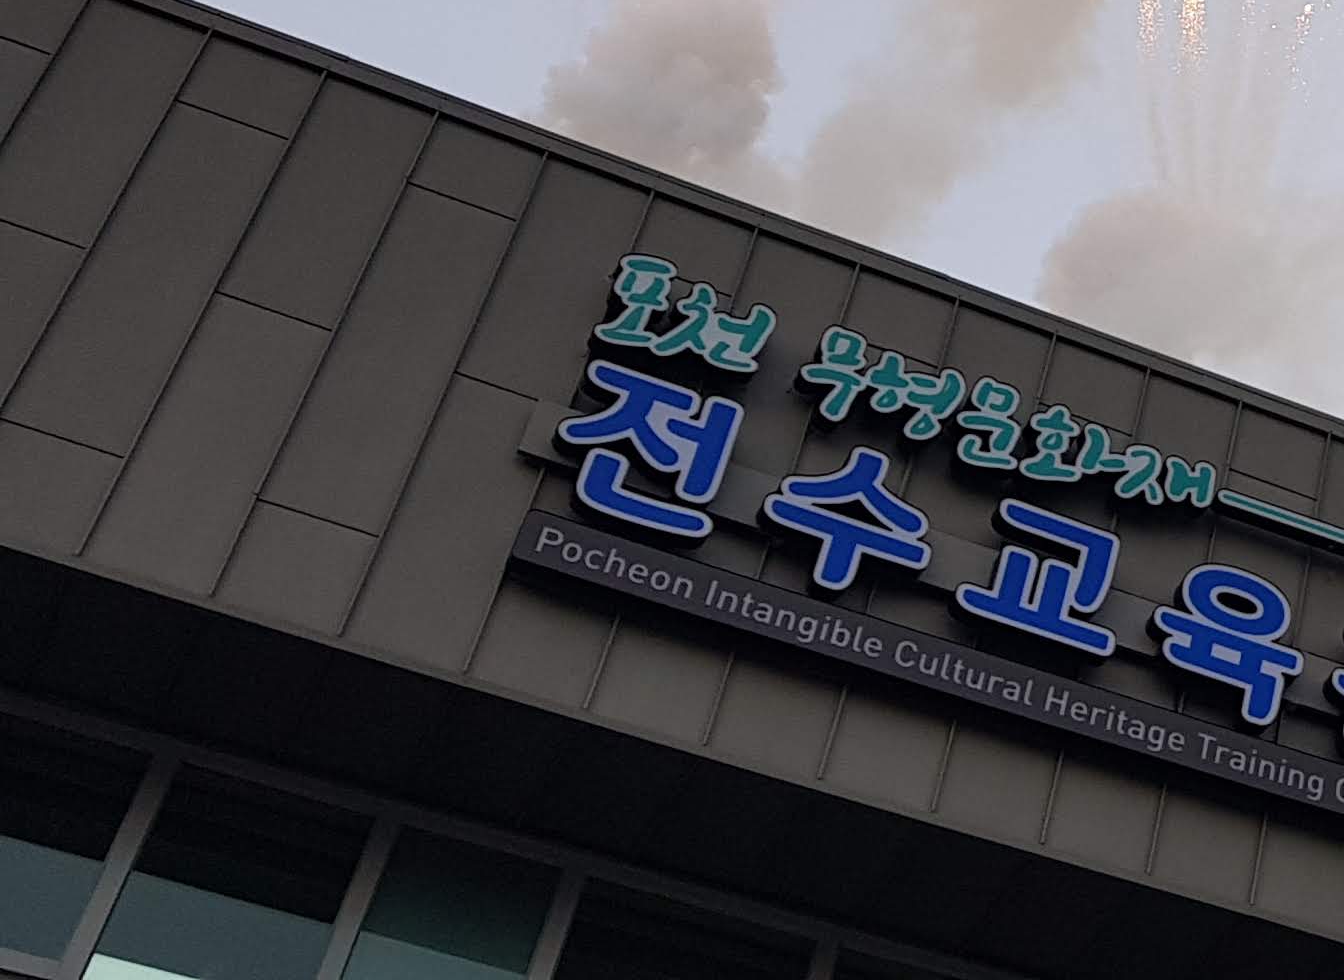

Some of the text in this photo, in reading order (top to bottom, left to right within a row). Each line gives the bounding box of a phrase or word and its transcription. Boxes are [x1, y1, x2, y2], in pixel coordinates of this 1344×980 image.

[595, 254, 1218, 507] 포천 무형문화재
[534, 525, 694, 600] Pocheon
[704, 579, 883, 659] Intangible
[894, 639, 1034, 707] Cultural
[1043, 685, 1186, 753] Heritage
[1198, 731, 1325, 801] Training
